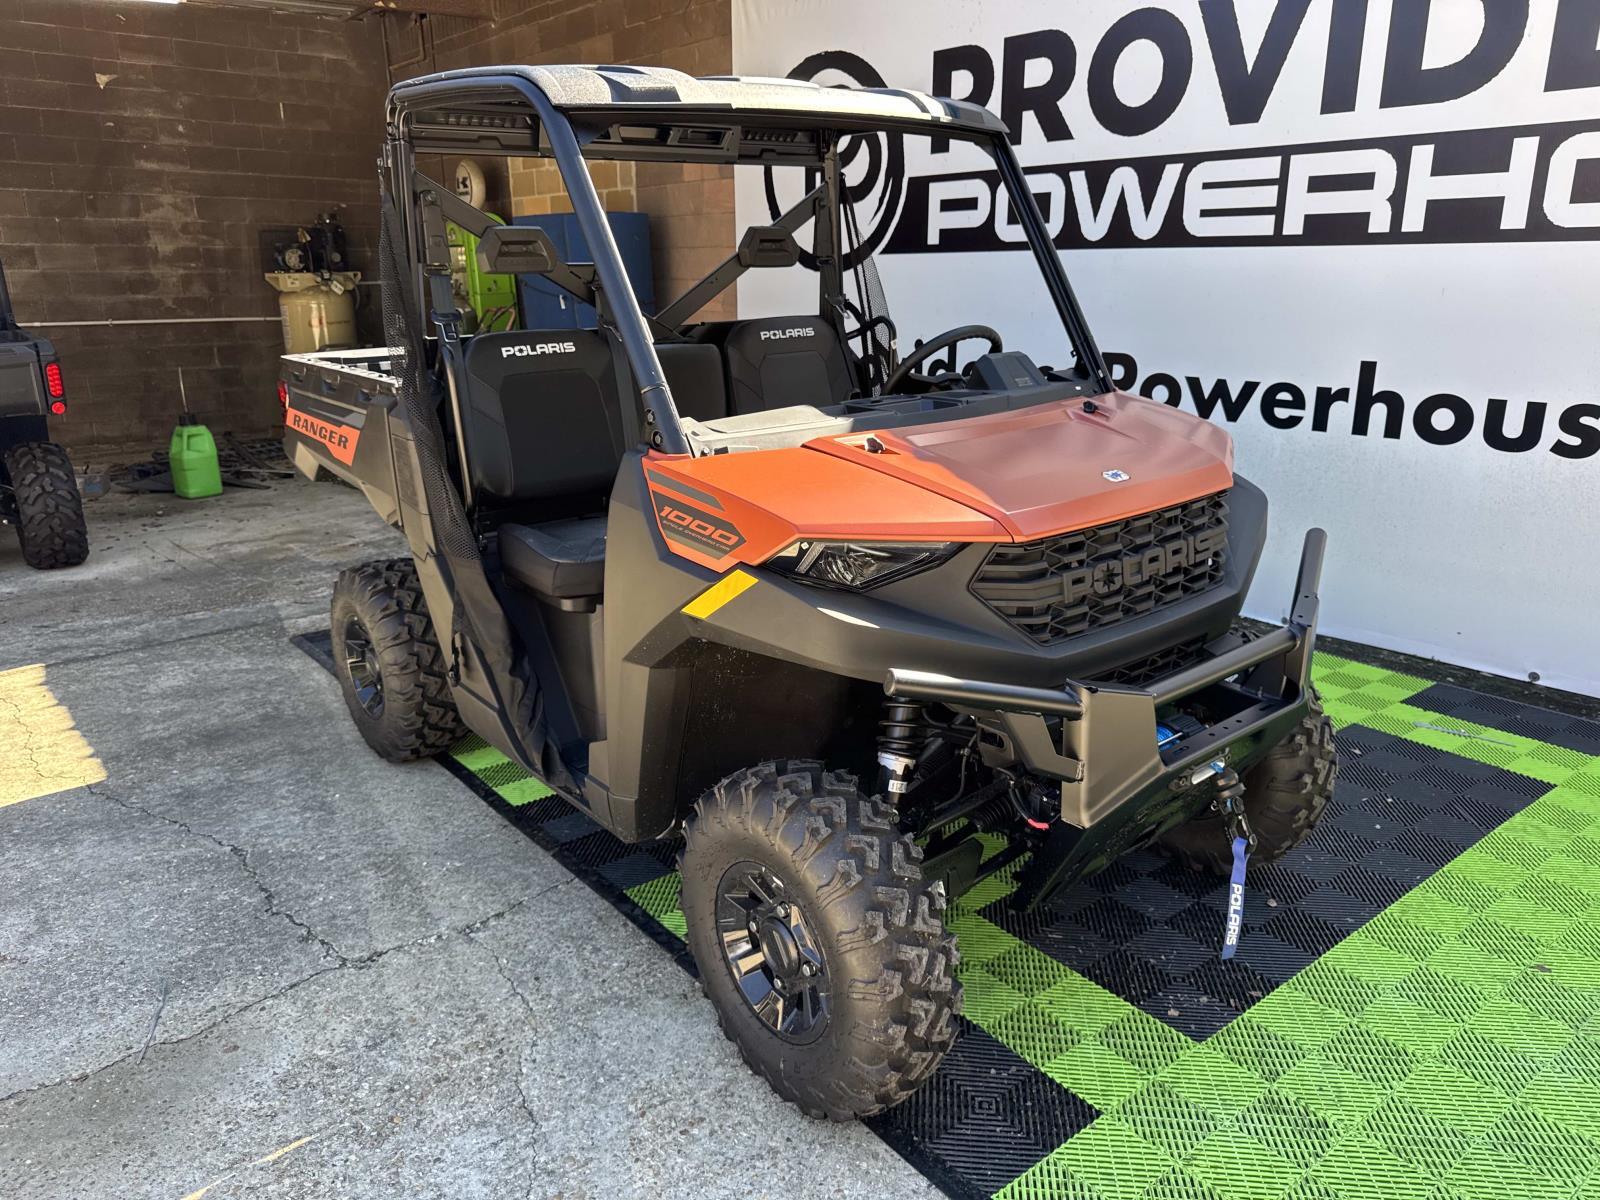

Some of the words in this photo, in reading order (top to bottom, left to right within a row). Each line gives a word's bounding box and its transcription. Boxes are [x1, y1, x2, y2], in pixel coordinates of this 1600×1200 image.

[501, 341, 576, 358] POLARIS
[760, 327, 815, 341] POLARIS
[293, 414, 349, 449] RANGER
[659, 505, 739, 546] 1000
[1063, 534, 1214, 604] POLARIS
[1226, 883, 1242, 946] POLARIS
